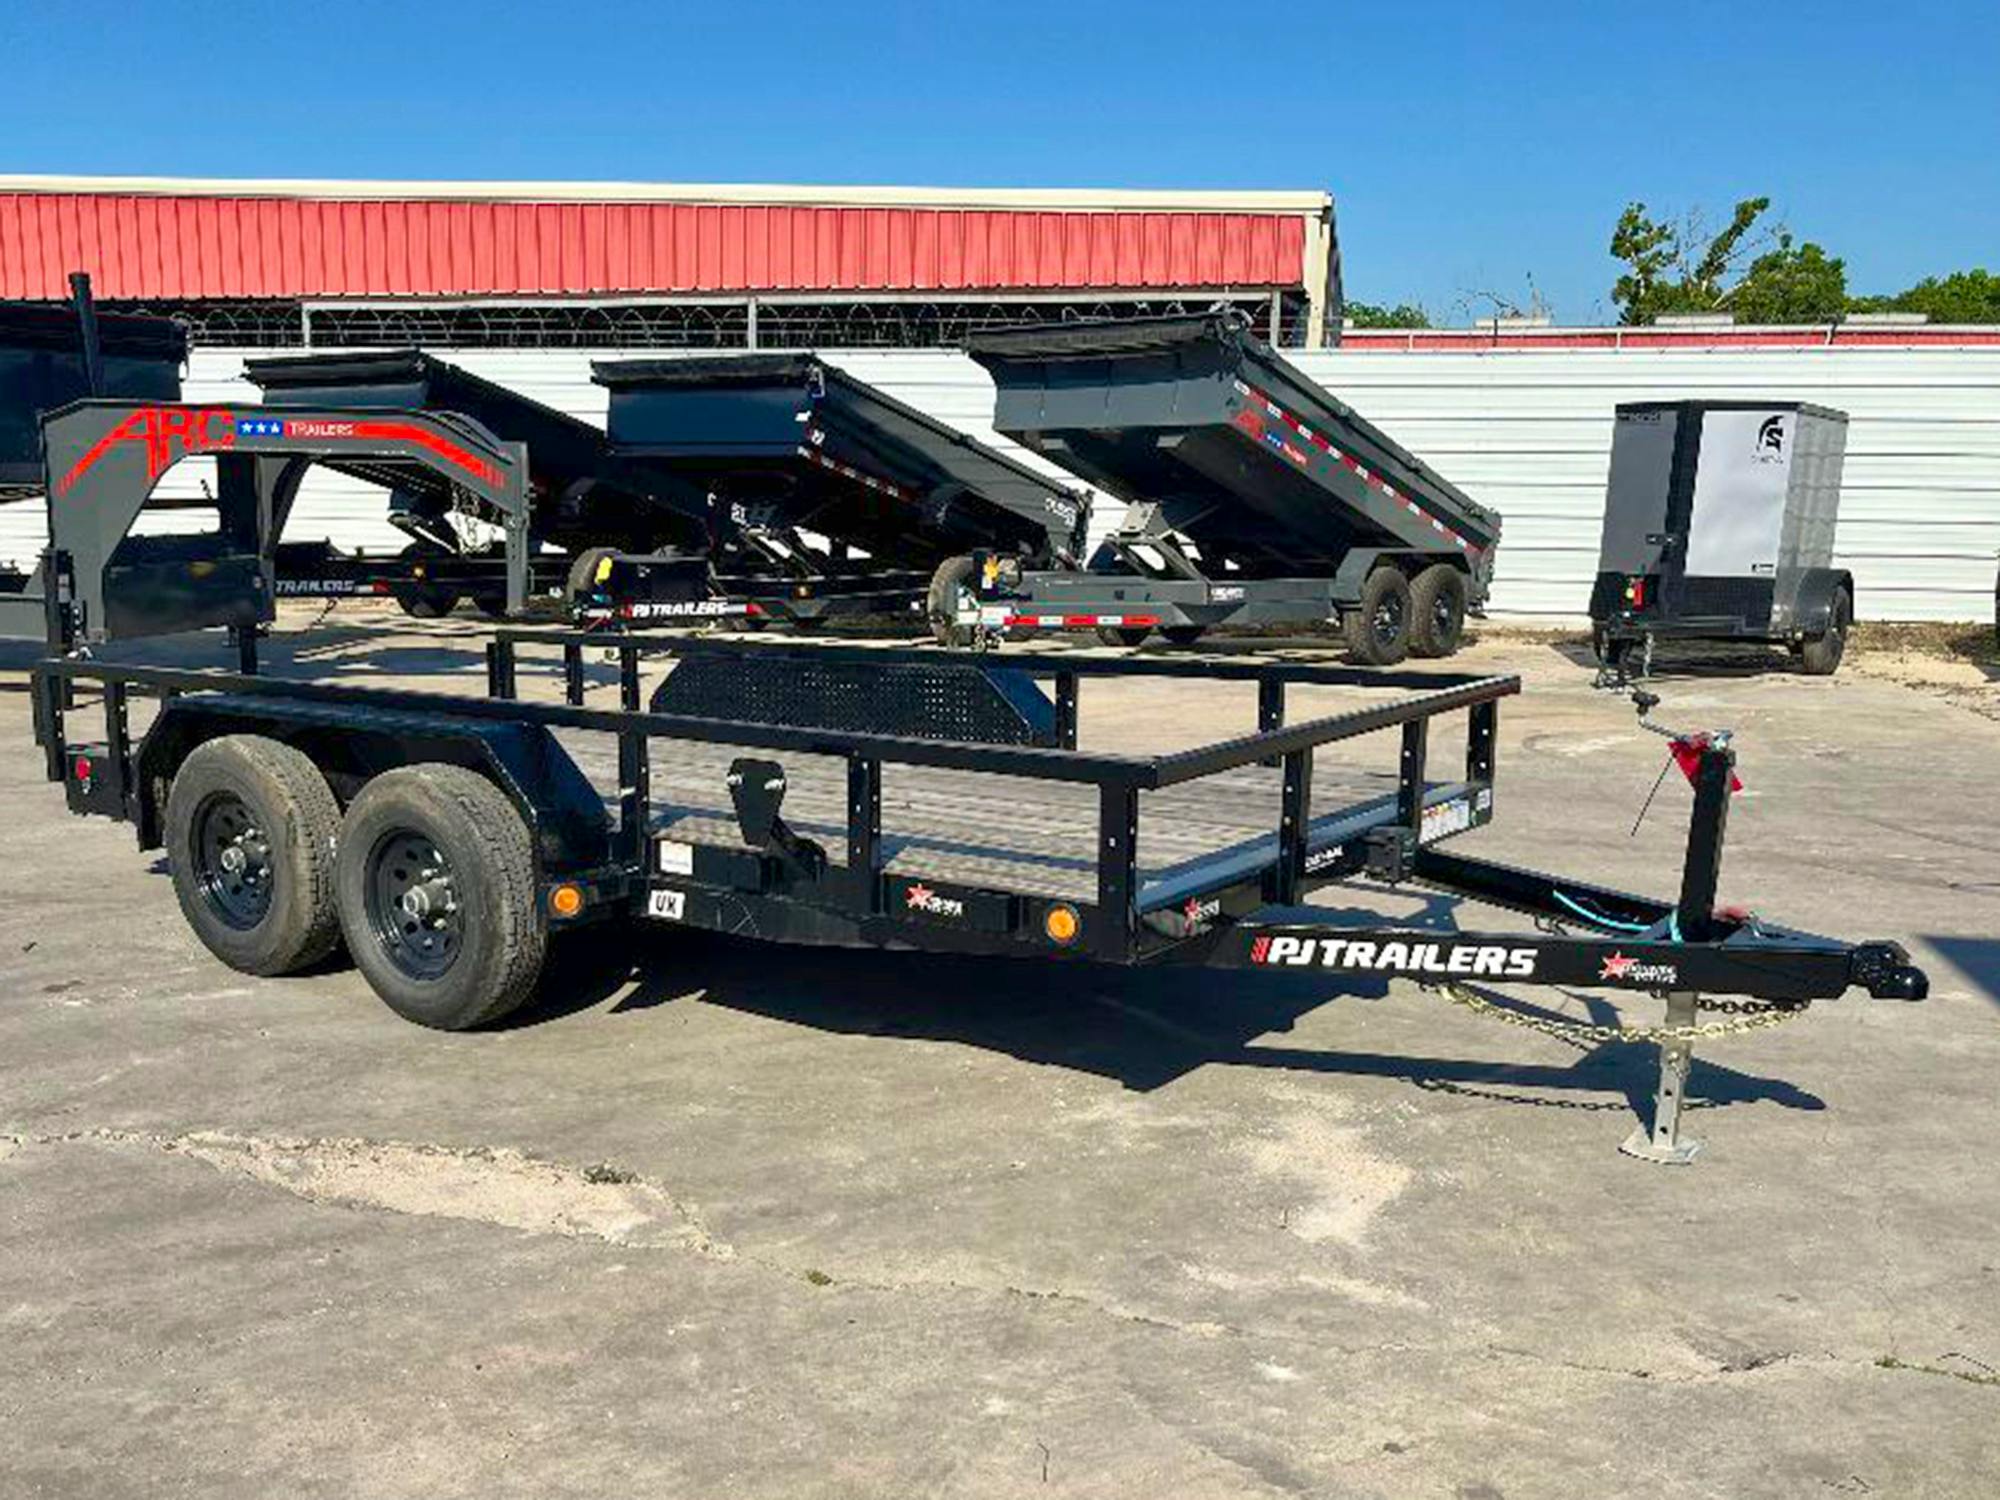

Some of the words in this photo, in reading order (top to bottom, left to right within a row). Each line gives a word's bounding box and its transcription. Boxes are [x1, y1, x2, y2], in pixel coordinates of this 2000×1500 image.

[290, 422, 354, 436] TRAILERS
[57, 406, 235, 495] ARC
[275, 580, 355, 593] TRAILERS
[1267, 937, 1315, 966] PJ
[1319, 939, 1538, 974] TRAILERS
